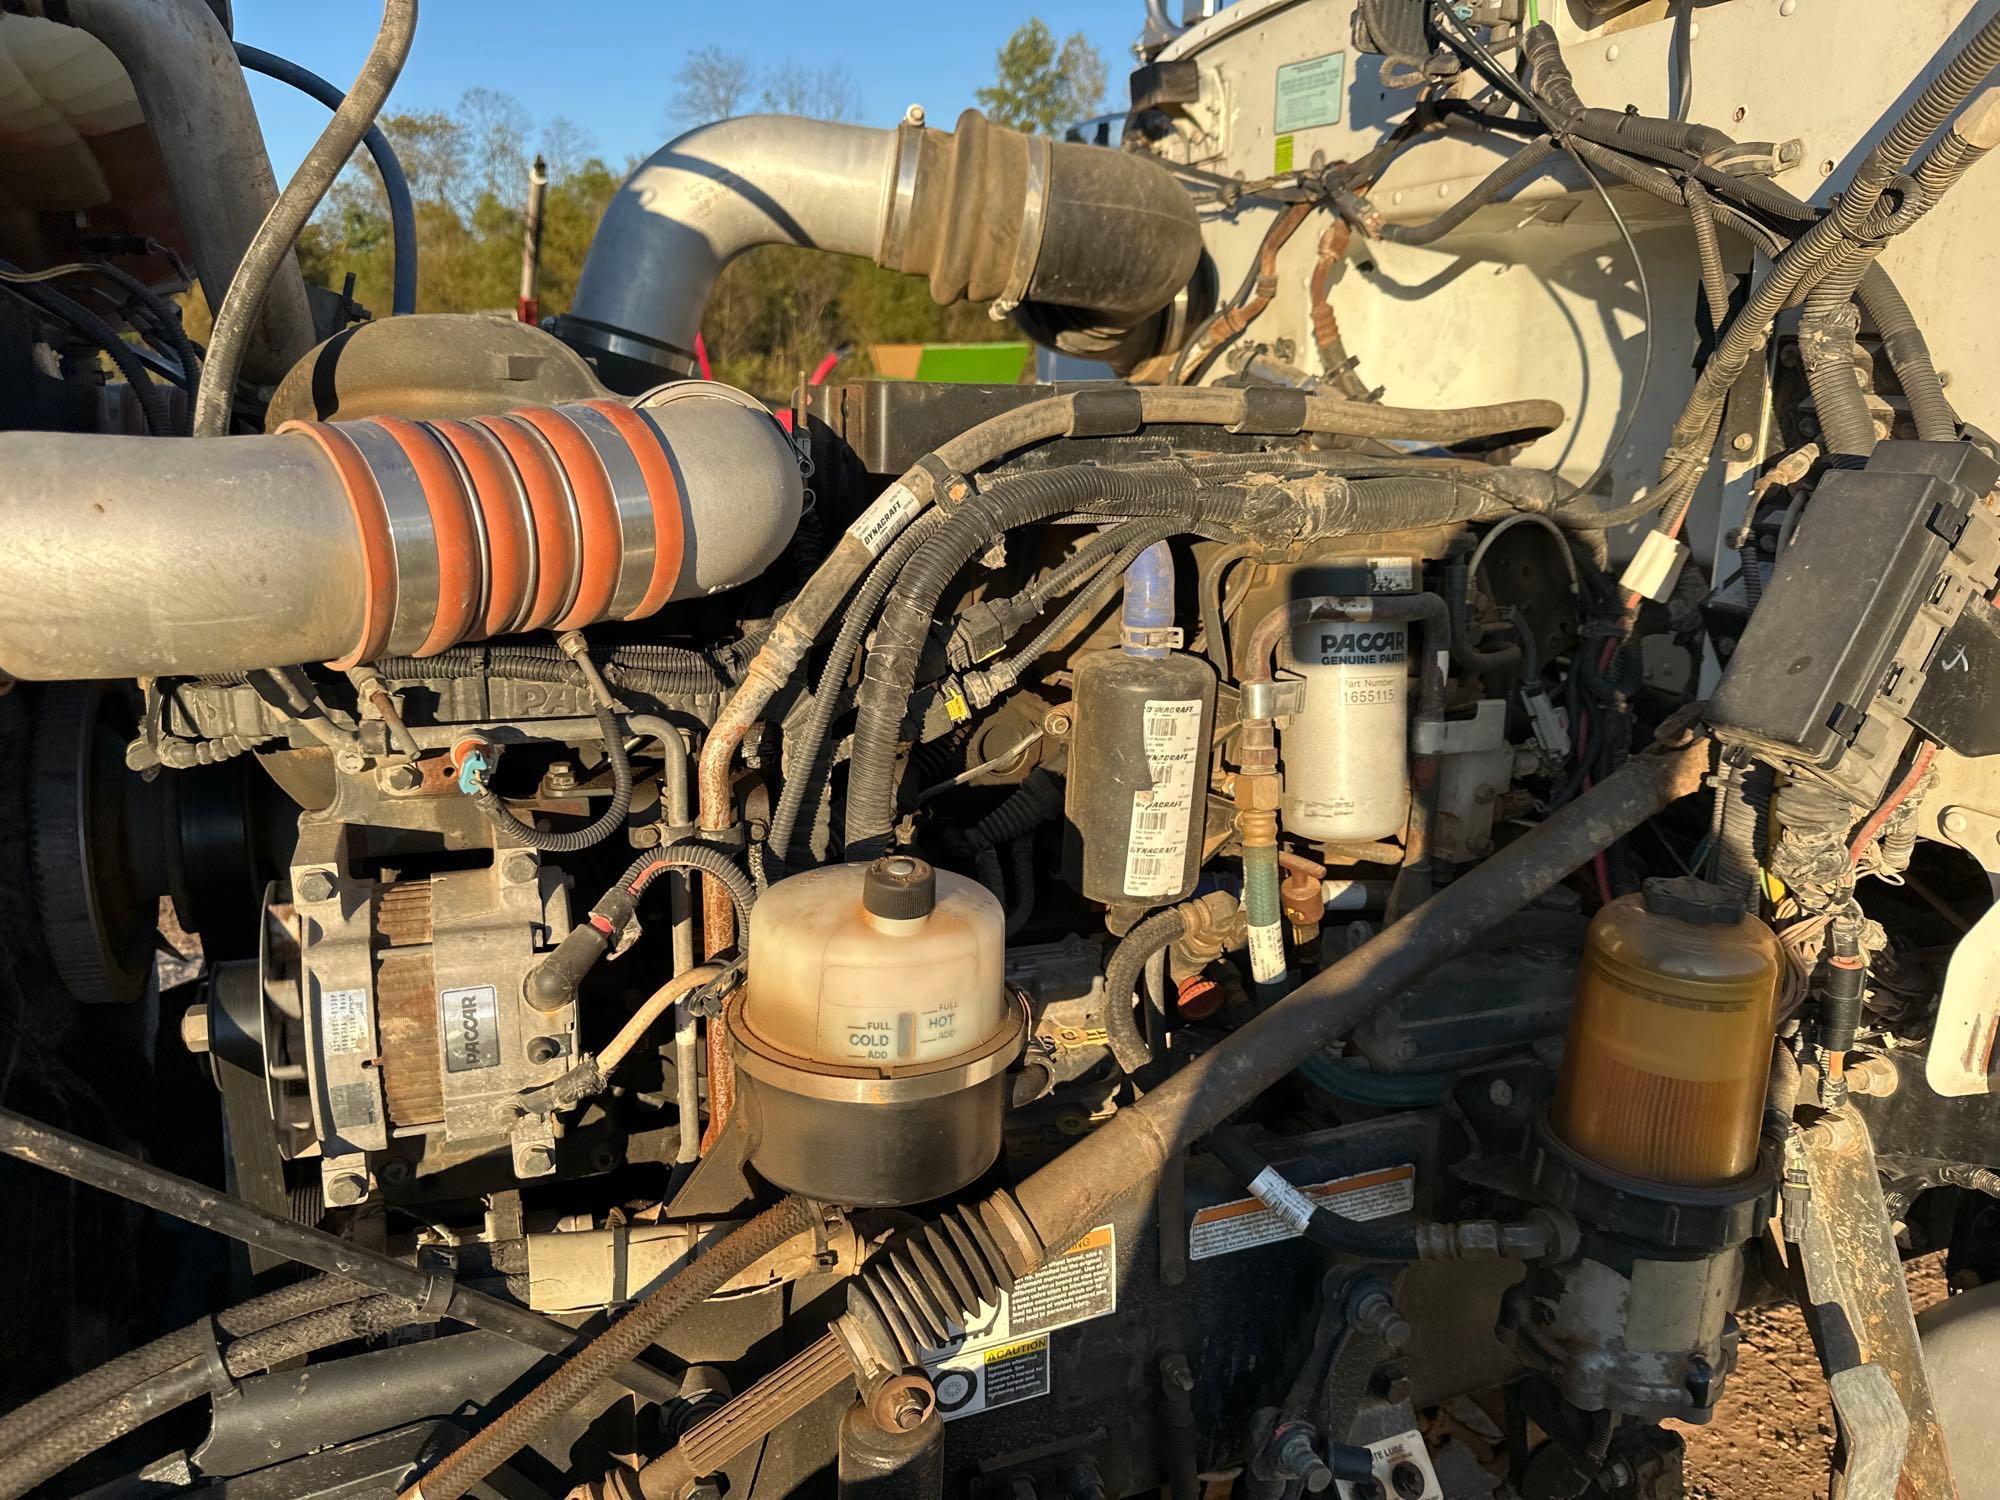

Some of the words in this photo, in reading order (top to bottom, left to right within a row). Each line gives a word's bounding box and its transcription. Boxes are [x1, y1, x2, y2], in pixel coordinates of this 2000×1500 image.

[864, 500, 902, 545] DYNACRAFT
[1321, 632, 1404, 653] PACCAR
[1322, 655, 1376, 665] GENUINE
[1365, 679, 1394, 687] Number
[1344, 689, 1394, 702] 1655115
[939, 1003, 959, 1011] FULL
[462, 995, 480, 1065] PACCAR
[867, 1022, 891, 1030] FULL
[929, 1013, 955, 1029] HOT
[850, 1034, 889, 1046] COLD
[868, 1050, 888, 1059] ADD
[1034, 1266, 1059, 1278] installed
[1078, 1256, 1100, 1267] original
[1014, 1278, 1042, 1291] quipment
[1083, 1264, 1095, 1272] Use
[1012, 1286, 1036, 1298] different
[1055, 1277, 1072, 1286] brand
[1012, 1295, 1029, 1304] cause
[1030, 1291, 1046, 1299] valve
[1046, 1287, 1061, 1295] stem
[1068, 1278, 1093, 1289] interfere
[1093, 1275, 1106, 1283] with
[1012, 1309, 1024, 1317] lead
[1053, 1296, 1074, 1306] vehicle
[1074, 1290, 1095, 1301] control
[1095, 1287, 1107, 1295] and
[1016, 1300, 1033, 1309] brake
[1034, 1292, 1066, 1305] component
[1067, 1287, 1085, 1296] which
[1012, 1316, 1024, 1325] may
[1025, 1312, 1038, 1320] lead
[1046, 1304, 1071, 1315] personal
[1072, 1299, 1090, 1309] injury.
[996, 1340, 1046, 1358] CAUTION
[1384, 1444, 1403, 1456] LUBE
